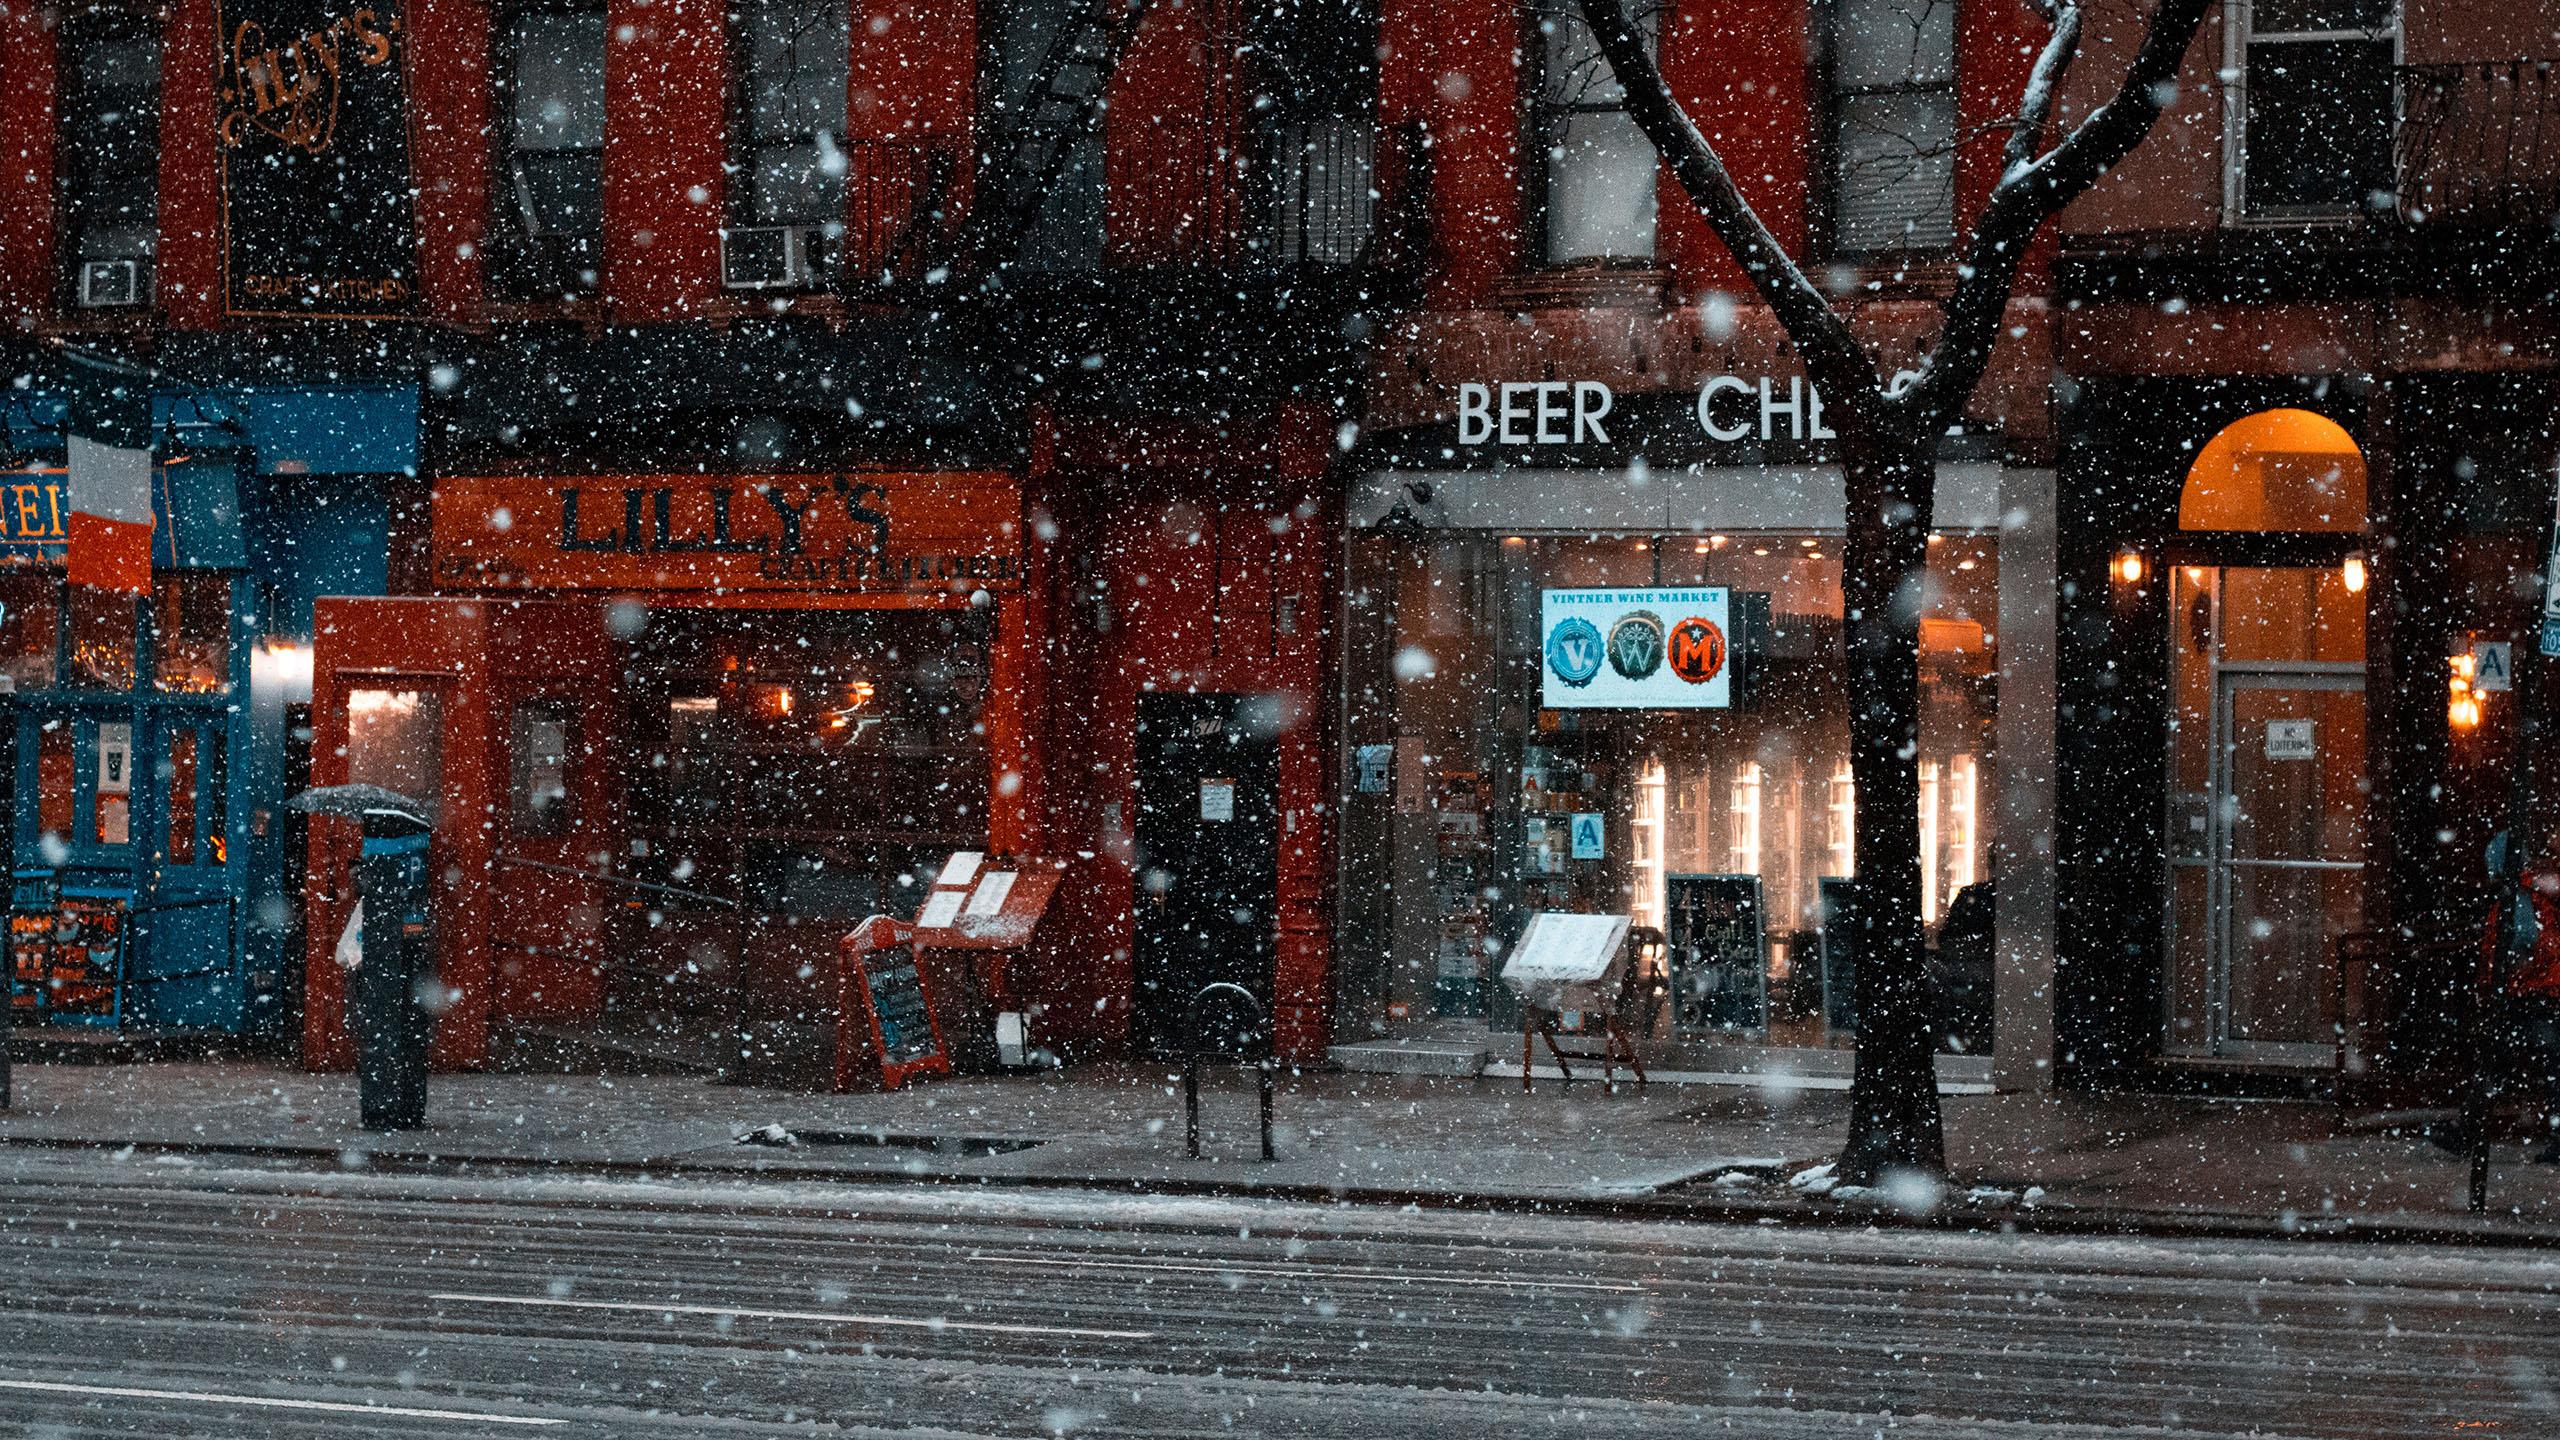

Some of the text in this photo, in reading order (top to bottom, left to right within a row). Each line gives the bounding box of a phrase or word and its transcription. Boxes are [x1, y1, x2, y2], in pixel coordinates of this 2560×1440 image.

[328, 279, 409, 299] KITCHEN
[1458, 382, 1611, 444] BEER
[558, 475, 889, 553] LILLY'S
[1552, 594, 1613, 604] VINTNER
[1658, 592, 1719, 602] MARKET
[1561, 638, 1590, 671] V
[1678, 632, 1713, 672] M
[2480, 648, 2503, 676] A
[2284, 728, 2296, 738] NO
[1577, 819, 1598, 846] A
